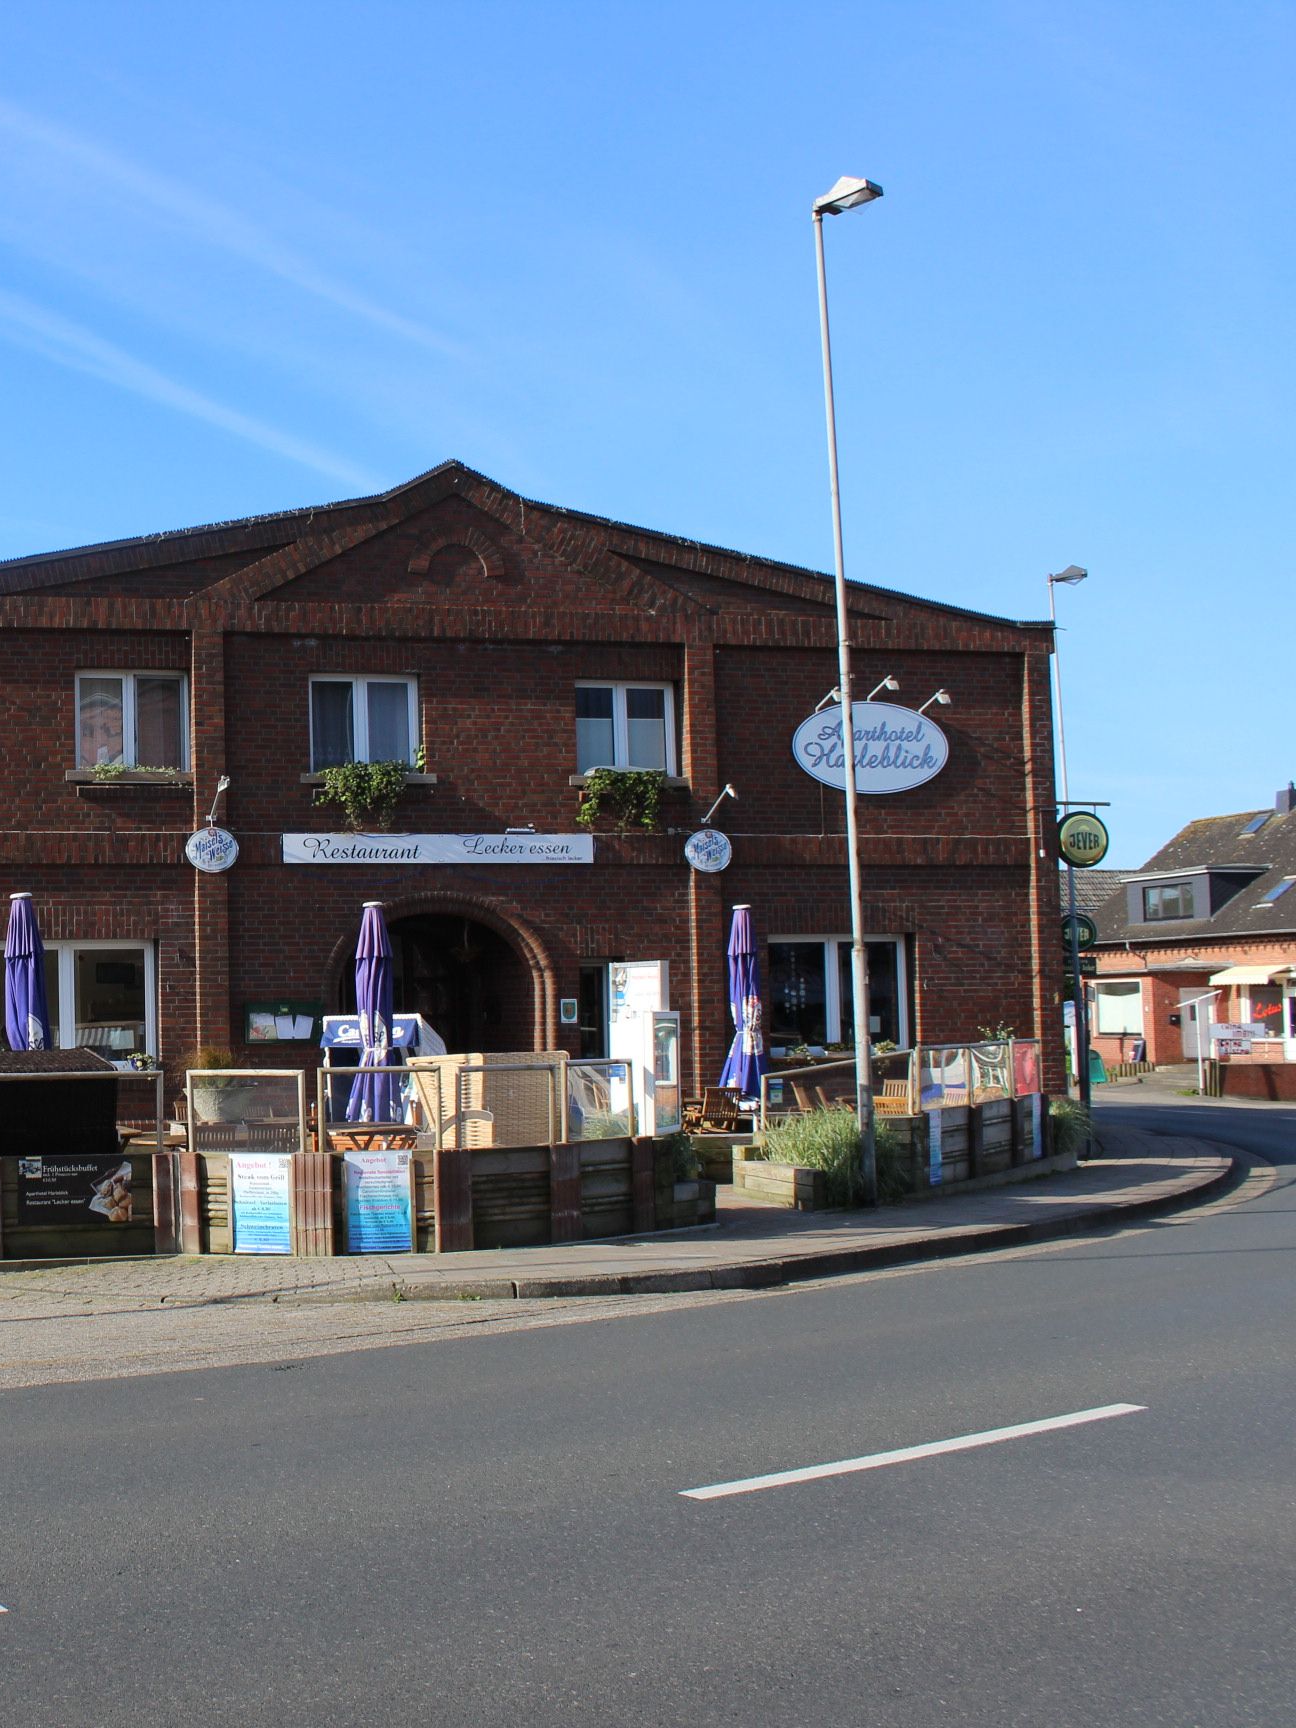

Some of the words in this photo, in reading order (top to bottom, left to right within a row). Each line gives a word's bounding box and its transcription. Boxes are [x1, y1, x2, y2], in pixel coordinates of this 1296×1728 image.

[818, 721, 924, 748] Aarthotel
[303, 837, 421, 860] Restaurant
[463, 836, 526, 855] Lecker
[529, 843, 572, 855] essen
[1069, 832, 1100, 850] JEVER
[43, 1164, 98, 1173] Frühstücksbuffet
[236, 1161, 267, 1169] Angebot
